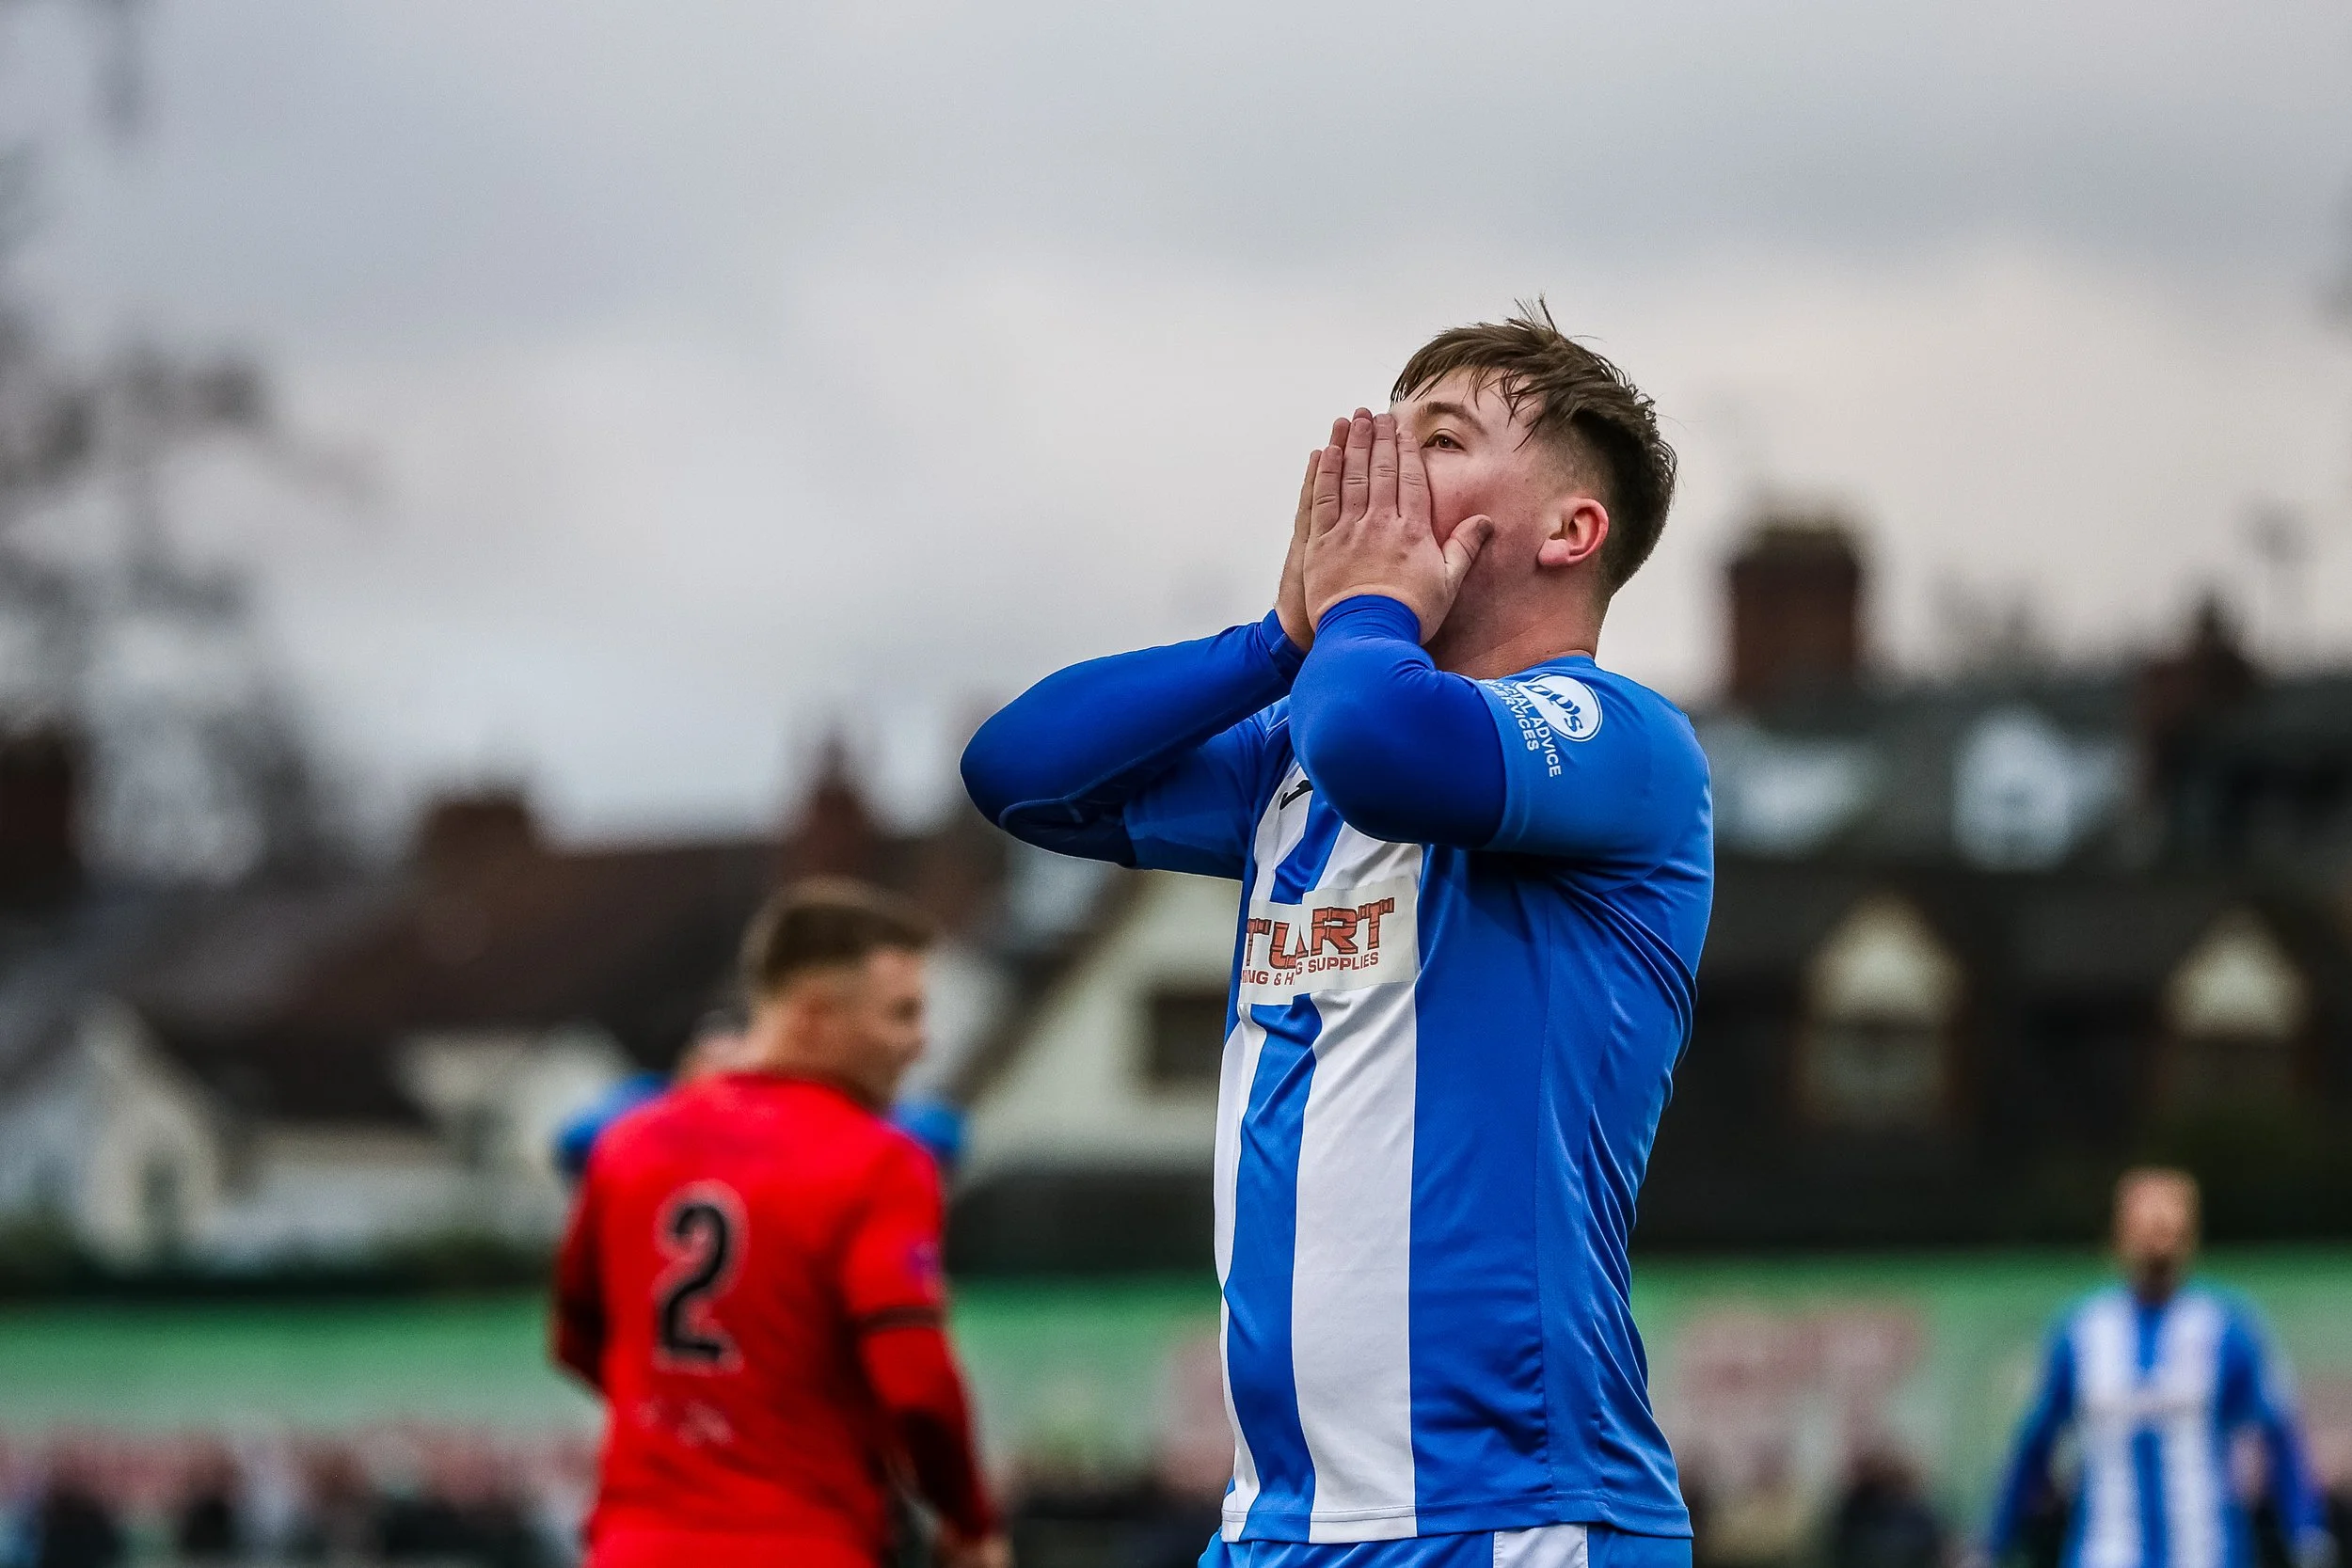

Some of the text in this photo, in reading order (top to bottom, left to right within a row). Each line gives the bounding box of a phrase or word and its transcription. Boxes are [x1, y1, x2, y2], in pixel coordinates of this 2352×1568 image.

[1529, 717, 1562, 778] ADVICE
[1308, 951, 1379, 974] SUPPLIES
[657, 1187, 739, 1370] 2
